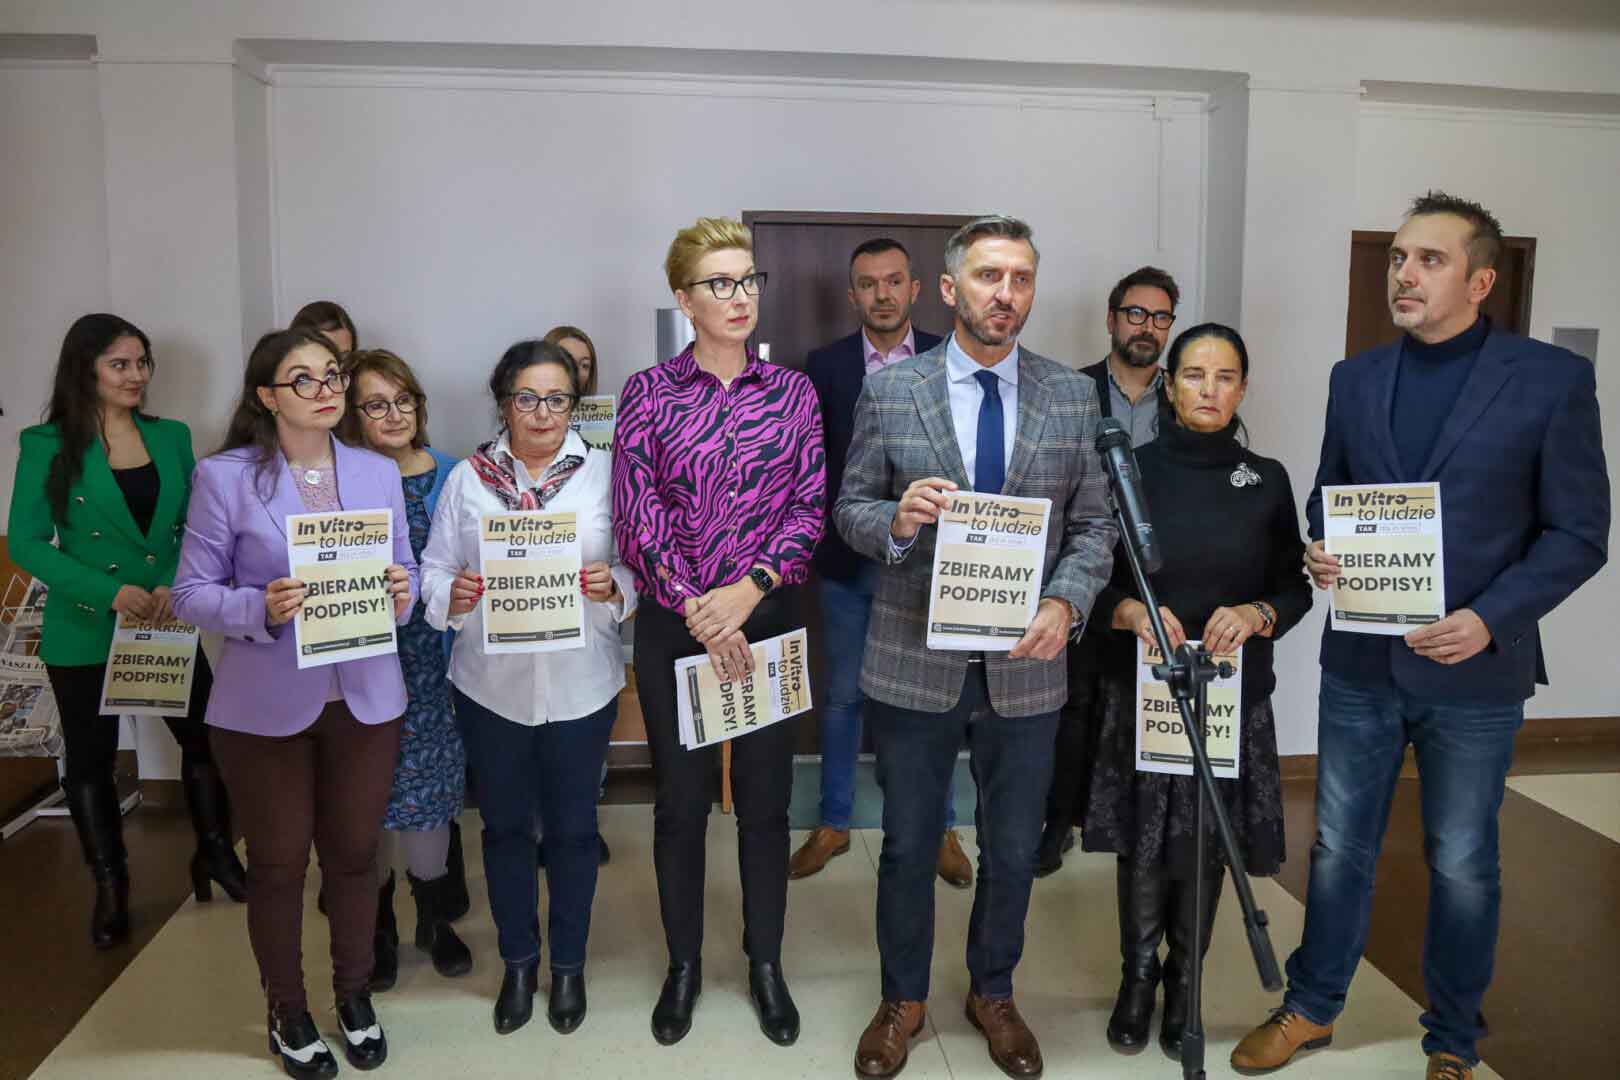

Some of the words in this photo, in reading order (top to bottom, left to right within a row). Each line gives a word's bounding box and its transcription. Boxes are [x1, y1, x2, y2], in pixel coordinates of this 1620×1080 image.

[1334, 493, 1353, 507] In
[1357, 490, 1408, 506] Vitro
[951, 500, 969, 515] In
[975, 501, 1021, 518] Vitro
[1358, 507, 1375, 521] to
[1379, 505, 1436, 521] ludzie
[298, 522, 315, 536] In
[319, 517, 365, 533] Vitro
[488, 519, 505, 532] In
[509, 516, 554, 532] Vitro
[971, 517, 988, 531] to
[990, 518, 1042, 536] ludzie
[319, 535, 336, 549] to
[338, 530, 389, 548] ludzie
[509, 533, 525, 546] to
[528, 529, 576, 545] ludzie
[939, 561, 1034, 582] ZBIERAMY
[487, 572, 577, 591] ZBIERAMY
[1336, 576, 1432, 591] PODPISY!
[491, 593, 574, 612] PODPISY!
[939, 585, 1028, 605] PODPISY!
[303, 597, 386, 621] PODPISY!
[789, 640, 801, 654] In
[112, 654, 191, 667] ZBIERAMY
[778, 660, 788, 673] to
[112, 671, 185, 685] PODPISY!
[789, 656, 803, 692] Vitro
[778, 675, 792, 714] ludzie
